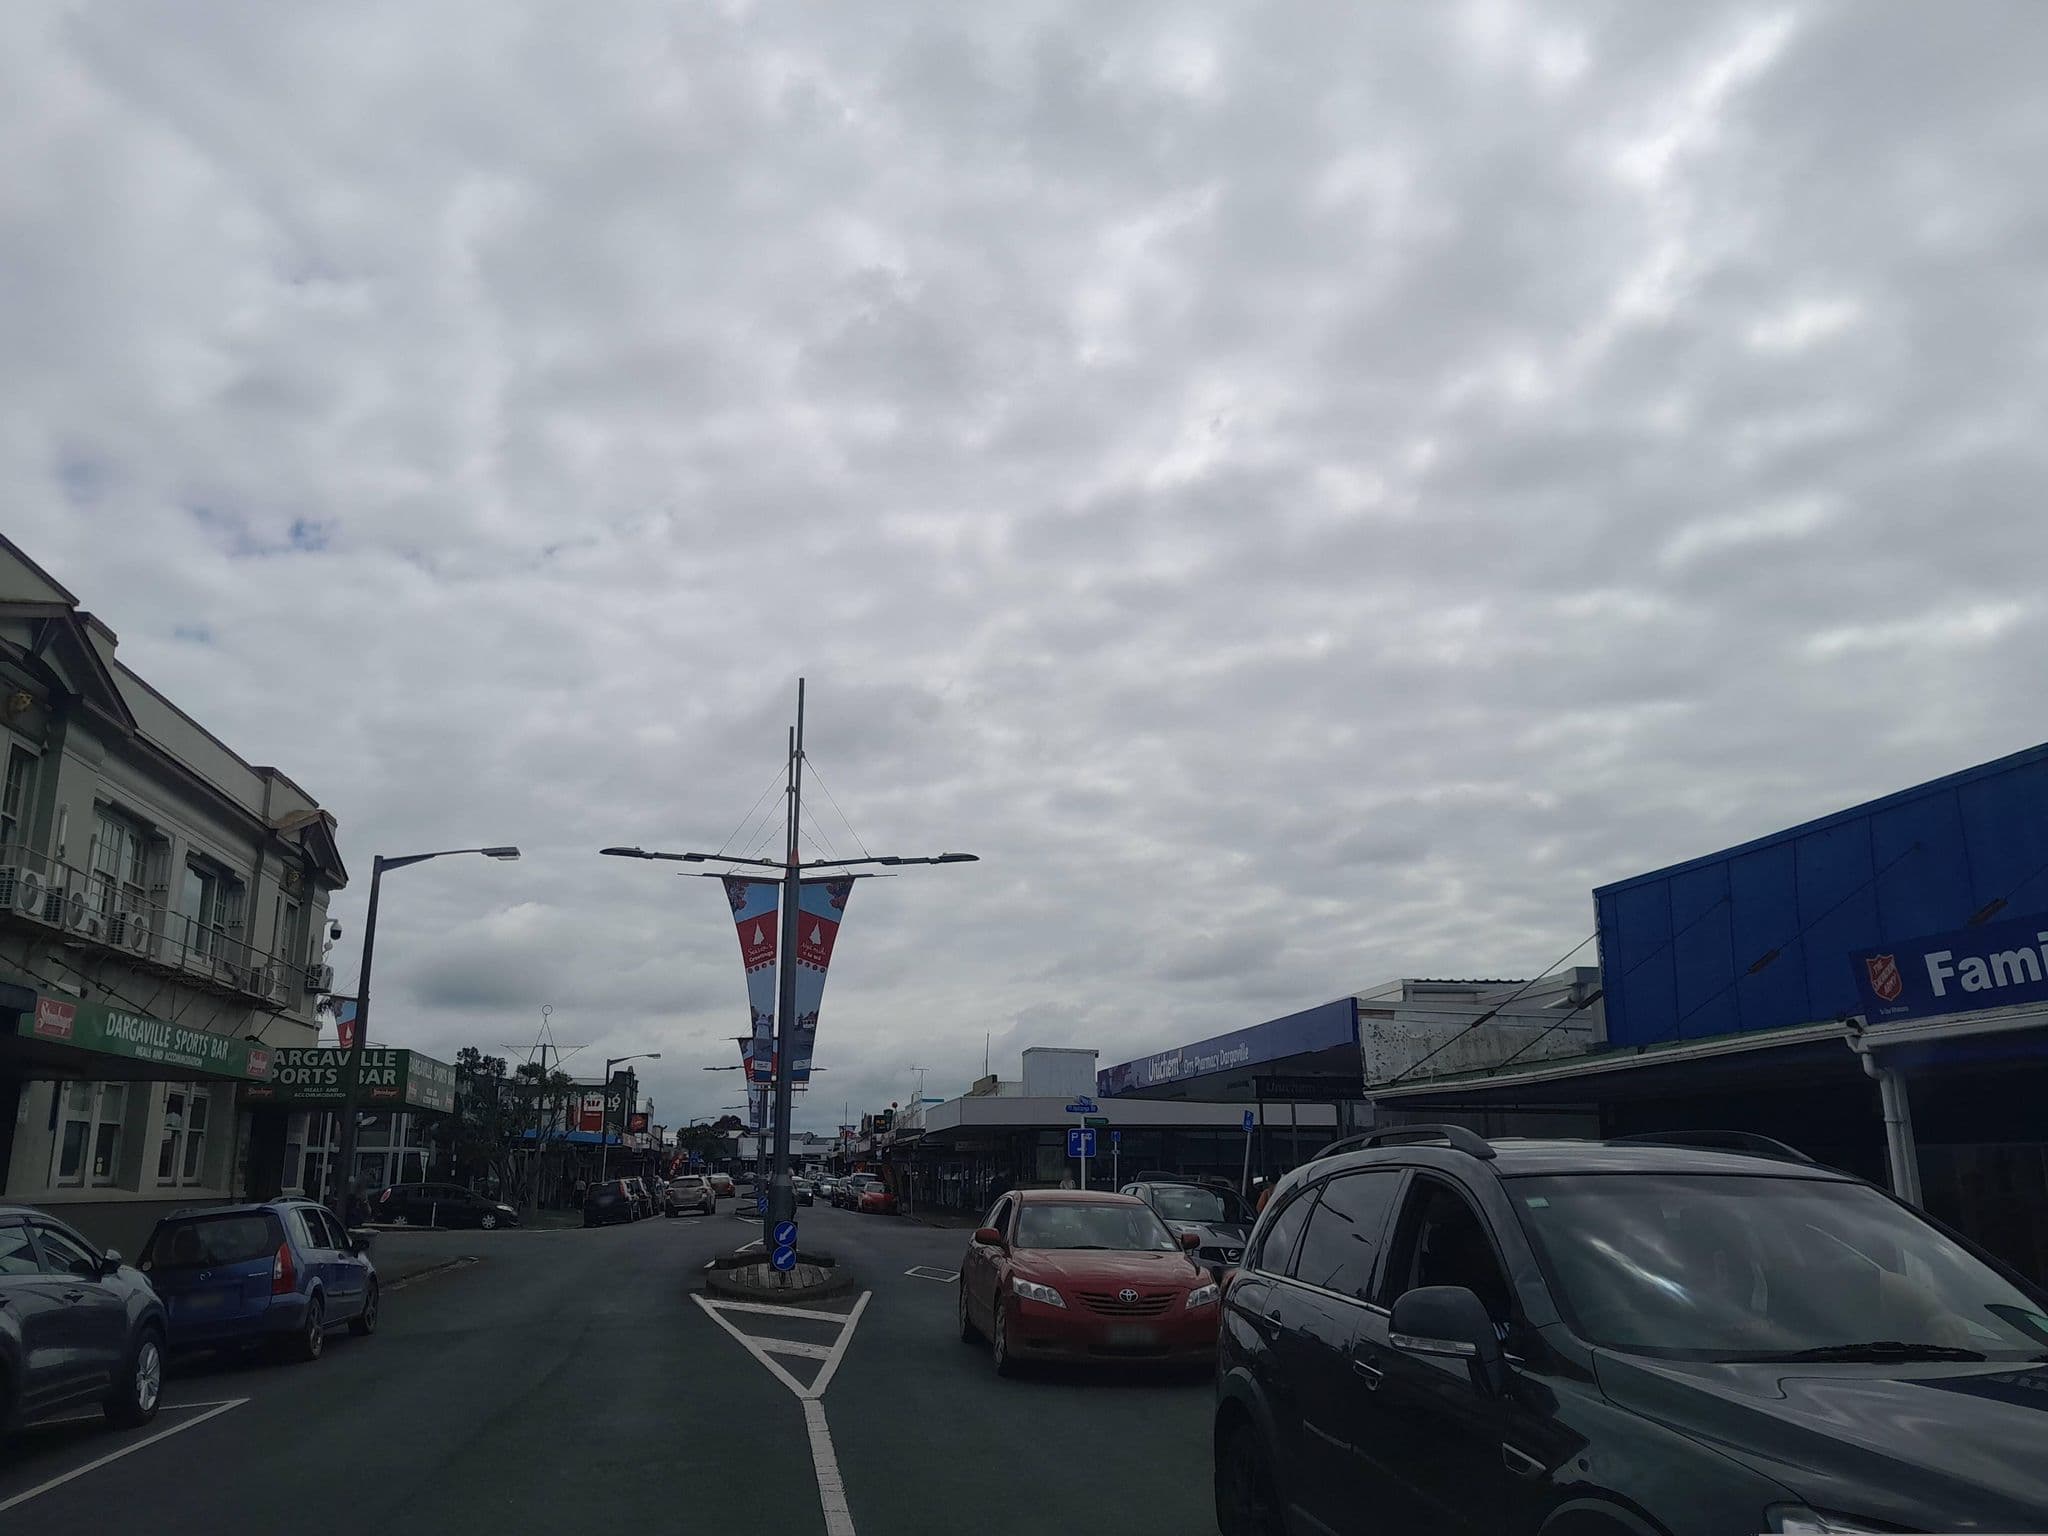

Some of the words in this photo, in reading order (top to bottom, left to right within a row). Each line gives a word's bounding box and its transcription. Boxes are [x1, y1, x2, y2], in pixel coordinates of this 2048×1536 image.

[105, 1012, 171, 1048] DARGAVILLE
[174, 1028, 209, 1057] SPORTS
[210, 1038, 229, 1061] BAR
[273, 1050, 397, 1067] ARGAVLLE
[1148, 1053, 1179, 1082] Unichem
[1195, 1052, 1220, 1073] Pharmacy
[1220, 1042, 1249, 1067] Dargaville
[271, 1068, 338, 1085] PORTS
[1071, 1132, 1079, 1142] P
